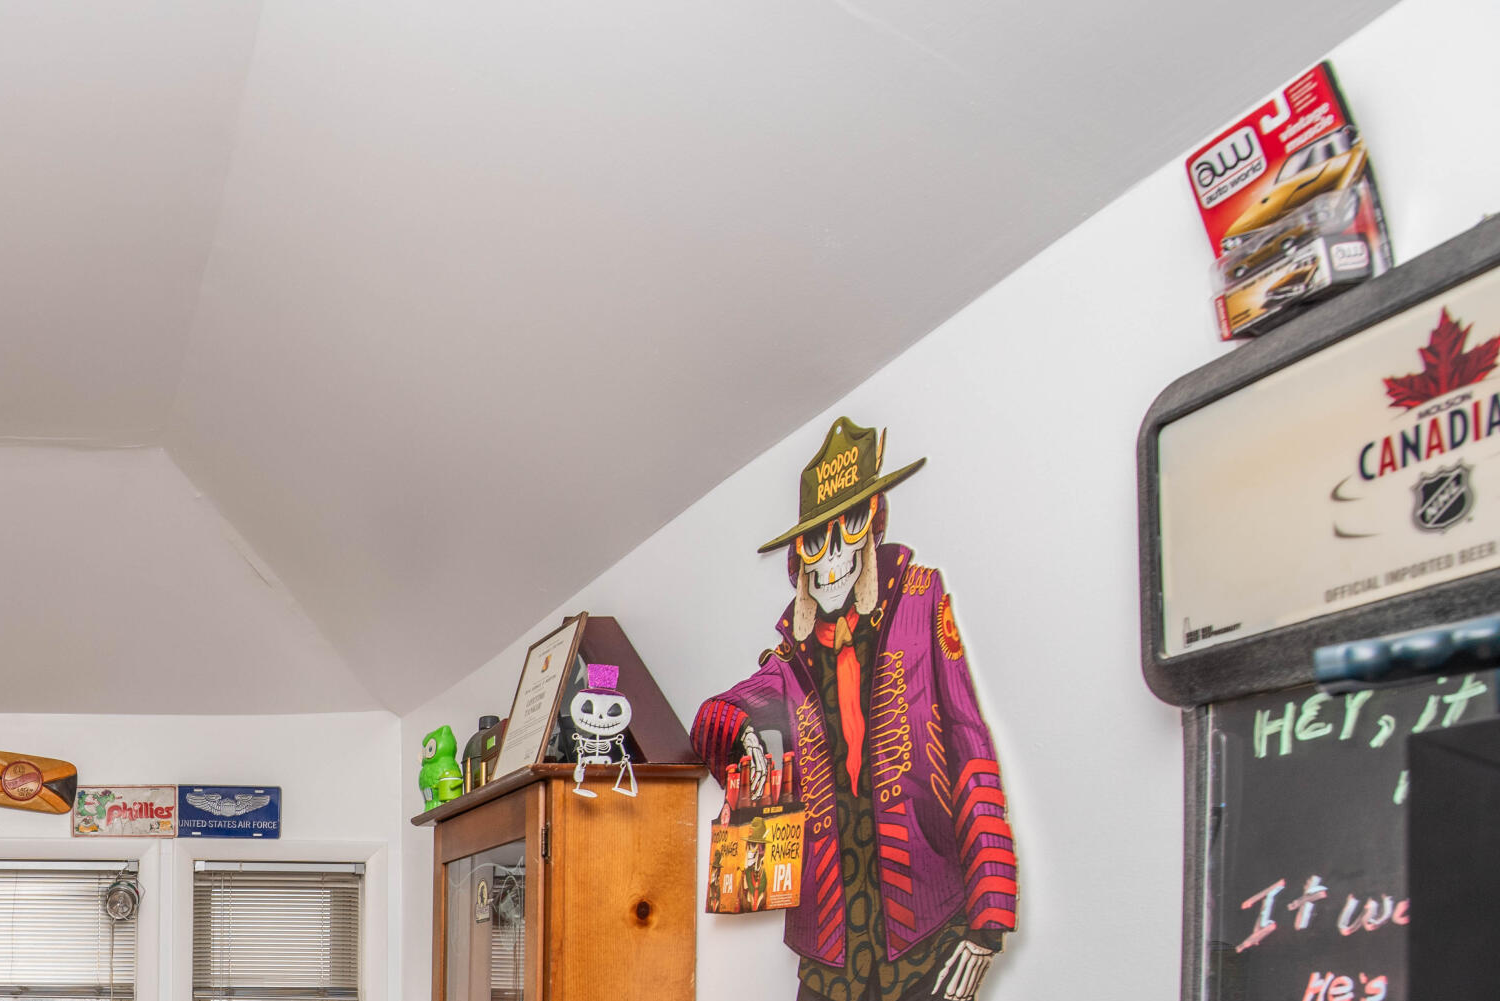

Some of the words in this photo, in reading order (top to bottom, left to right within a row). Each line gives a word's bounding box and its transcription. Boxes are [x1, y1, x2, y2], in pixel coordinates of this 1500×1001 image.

[1205, 182, 1230, 206] auto
[1229, 159, 1263, 190] world
[1416, 390, 1474, 420] MOLSON
[1359, 391, 1500, 481] CANADIA
[816, 446, 859, 484] VOODOO
[817, 464, 861, 505] RANGER
[1325, 571, 1381, 602] OFFICIAL
[1384, 553, 1455, 586] IMPORTED
[1458, 540, 1497, 566] BEER
[1411, 673, 1488, 735] it
[178, 819, 207, 829] UNITED
[208, 819, 236, 829] STATES
[237, 820, 251, 829] AIR
[252, 821, 277, 830] FORCE
[770, 823, 802, 843] VOODOO
[770, 840, 800, 863] RANGER
[722, 873, 733, 894] IPA
[773, 862, 793, 893] IPA
[1235, 877, 1328, 953] It
